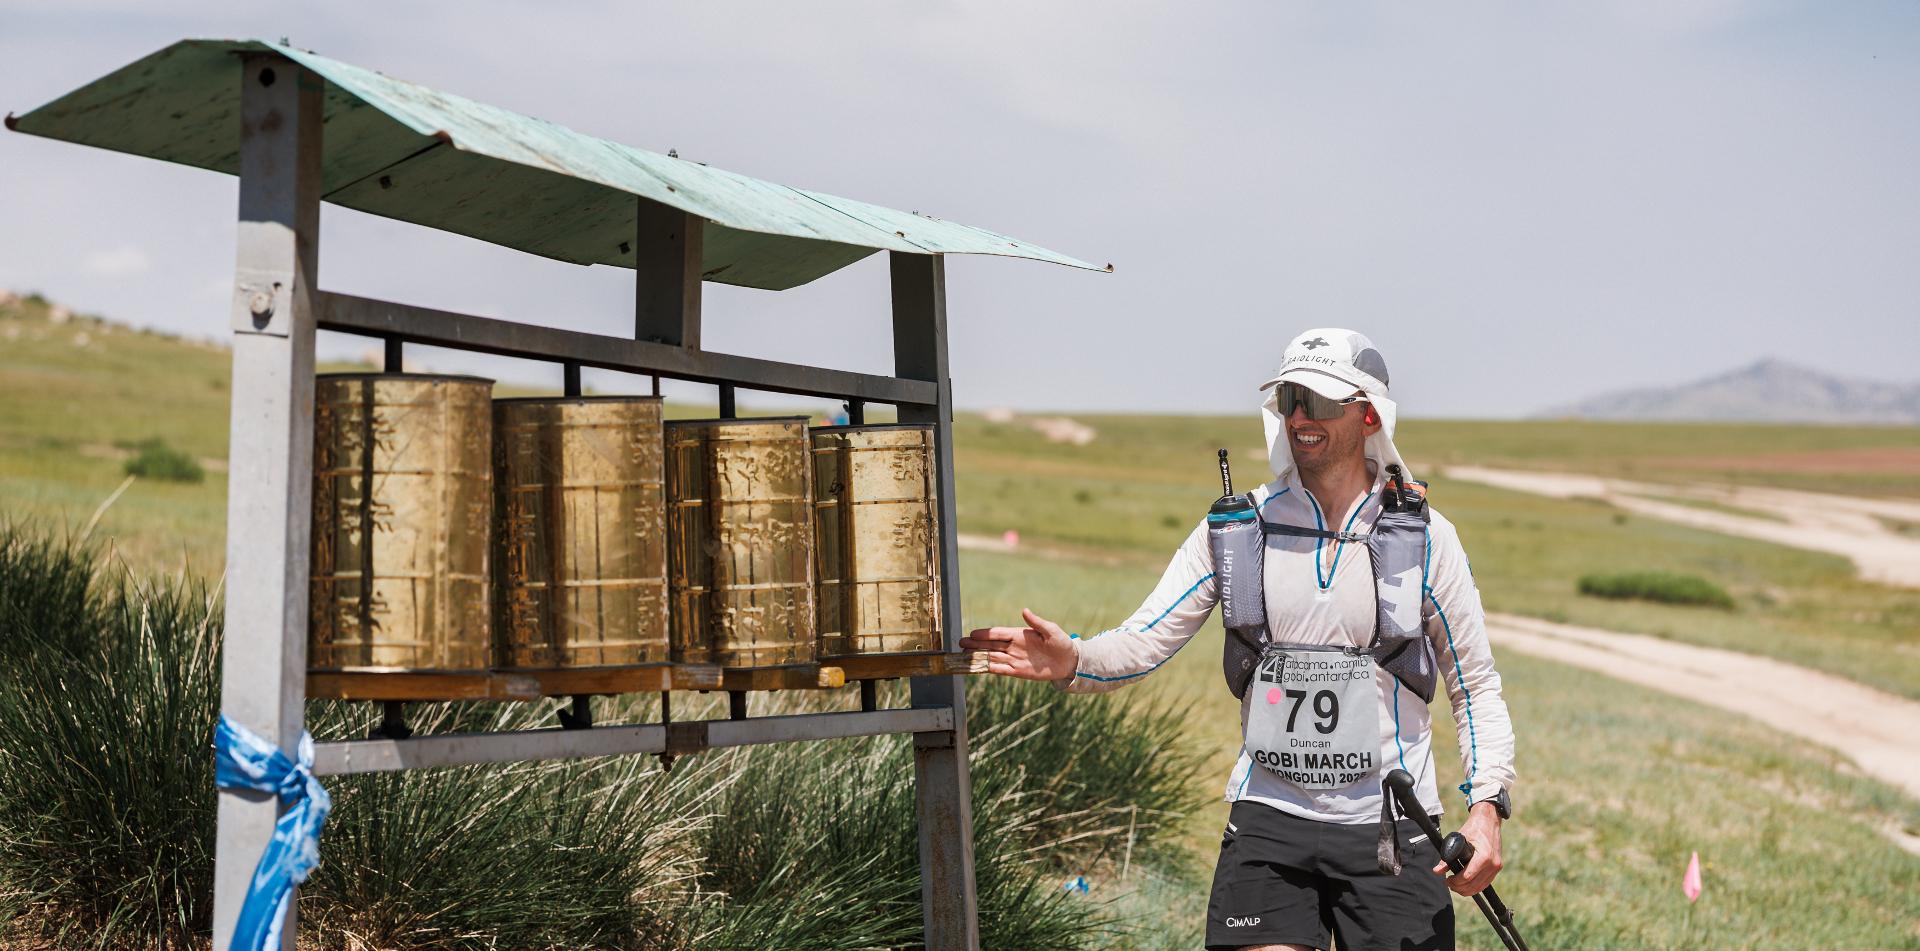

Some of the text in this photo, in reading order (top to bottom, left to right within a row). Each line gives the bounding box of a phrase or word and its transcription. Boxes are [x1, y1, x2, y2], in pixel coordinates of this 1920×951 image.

[1223, 548, 1234, 618] RAIDLIGHT
[1285, 689, 1340, 735] 79
[1290, 738, 1331, 748] Duncan
[1254, 749, 1372, 770] GOBI MARCH
[1264, 766, 1335, 787] MONGOLIA)
